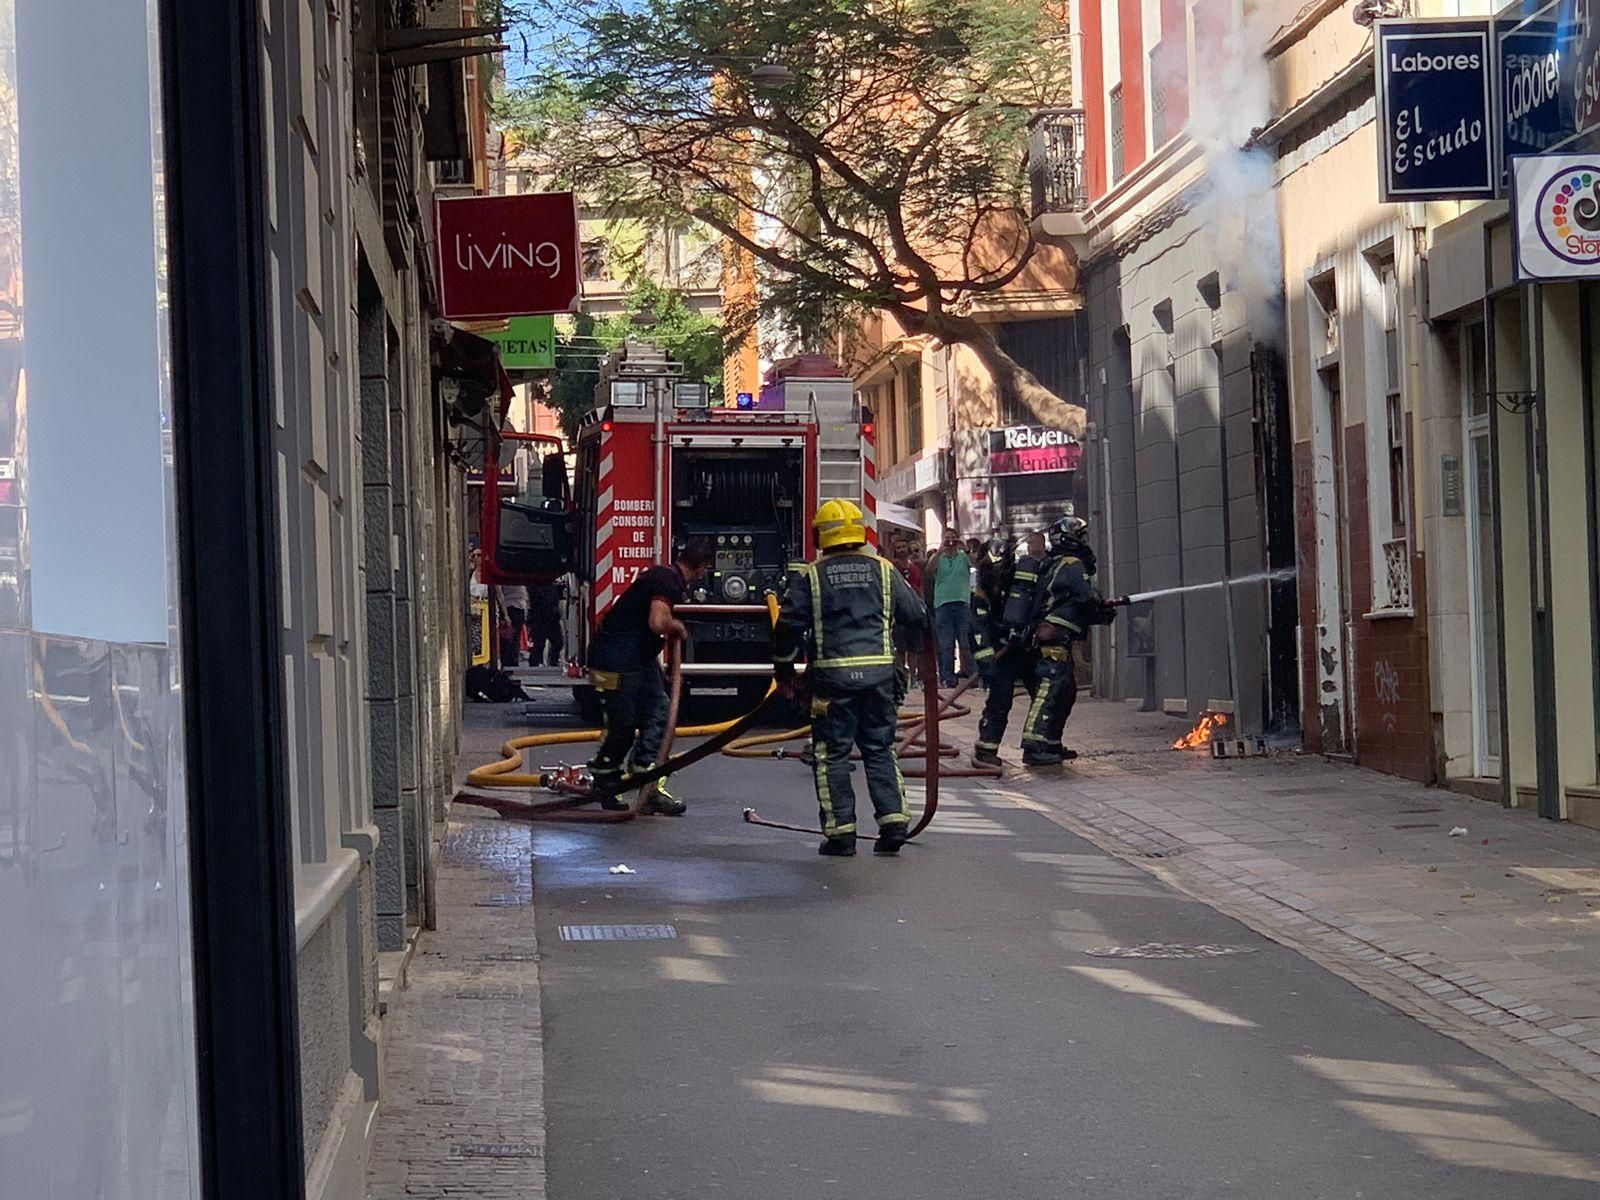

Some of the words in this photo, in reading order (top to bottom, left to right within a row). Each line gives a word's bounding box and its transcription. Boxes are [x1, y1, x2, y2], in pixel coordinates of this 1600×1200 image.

[1391, 52, 1480, 73] Labores
[1396, 105, 1423, 141] El
[1394, 118, 1482, 174] Escudo
[614, 500, 655, 511] BOMBER
[632, 531, 645, 542] DE
[618, 547, 657, 558] TENERIF
[826, 563, 871, 574] BOMBEROS
[612, 566, 649, 584] M-7
[827, 573, 873, 584] TENERIFE
